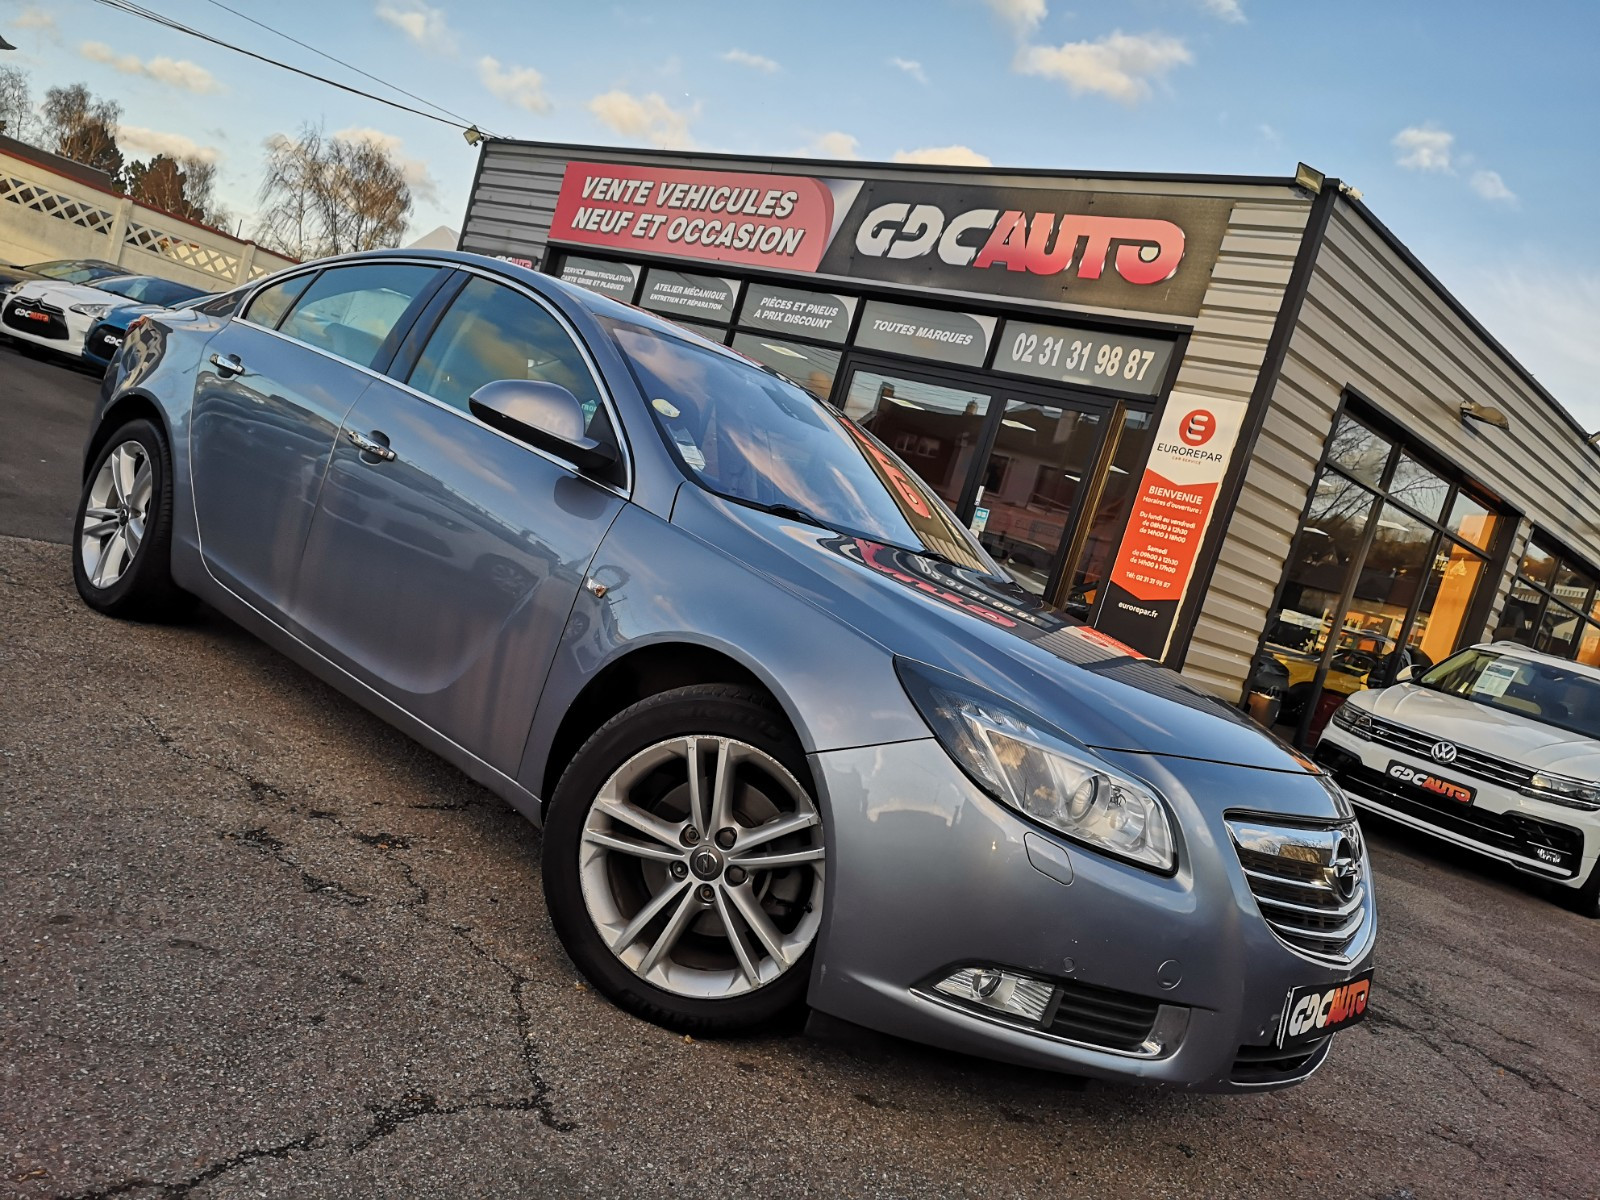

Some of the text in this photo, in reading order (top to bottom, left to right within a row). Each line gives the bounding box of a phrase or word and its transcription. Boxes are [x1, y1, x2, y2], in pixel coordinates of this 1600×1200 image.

[581, 176, 798, 218] VENTE VEHICULES
[571, 207, 804, 254] NEUF ET OCCASION
[855, 202, 1186, 285] GDCAUTO
[563, 266, 585, 276] SERVICE
[600, 281, 625, 291] PLAQUES
[654, 283, 728, 300] ATELIER MÉCANIQUE
[650, 294, 678, 304] ENTRETIEN
[686, 298, 723, 310] RÉPARATION
[760, 296, 838, 317] PIÈCES ET PNEUS
[754, 310, 832, 329] A PRIX DISCOUNT
[872, 320, 974, 346] TOUTES MARQUES
[1012, 332, 1155, 382] 02 31 31 98 87
[1156, 442, 1223, 462] EUROREPAR
[1148, 485, 1204, 505] BIENVENUE
[1142, 496, 1166, 507] Horaires
[1166, 502, 1198, 514] d'ouverture
[1148, 512, 1162, 522] lundi
[1170, 518, 1196, 529] vendredi
[1147, 528, 1165, 538] 14h00
[1172, 526, 1188, 536] 12h30
[1147, 544, 1168, 555] Samedi
[1158, 564, 1176, 574] 17h00
[1162, 556, 1178, 566] 12h30
[1136, 574, 1144, 582] 02
[1118, 601, 1158, 619] eurorepar.fr
[1390, 765, 1471, 802] GDCAUTO
[1288, 978, 1370, 1037] GDCAUTO
